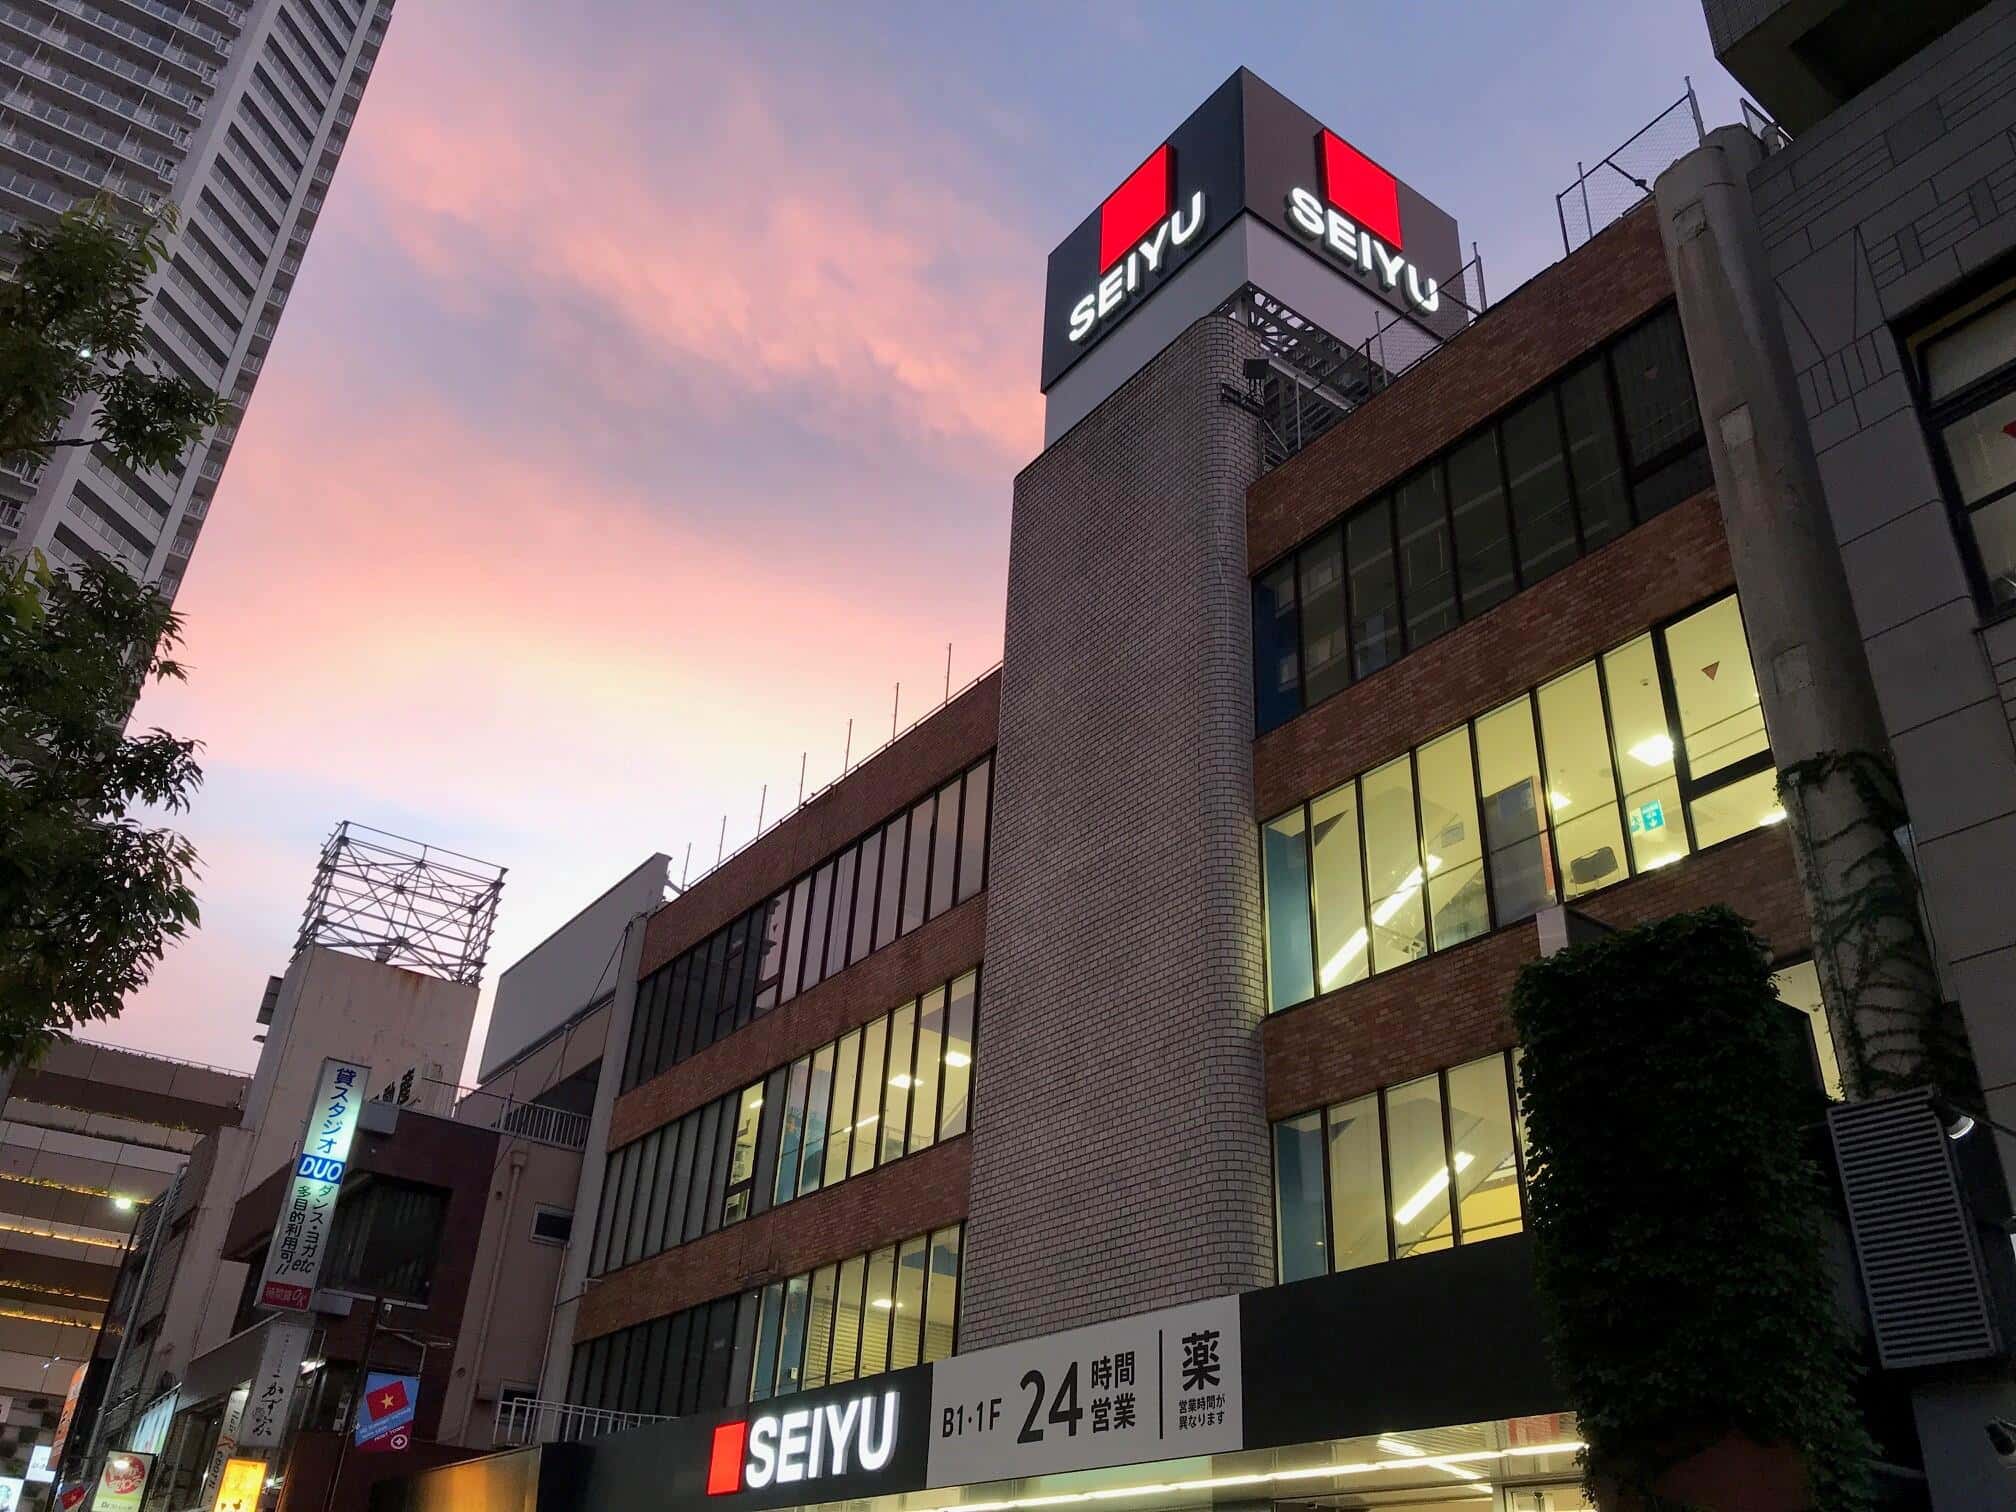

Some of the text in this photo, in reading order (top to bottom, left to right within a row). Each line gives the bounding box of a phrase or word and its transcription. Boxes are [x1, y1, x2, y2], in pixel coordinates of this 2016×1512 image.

[1069, 190, 1204, 342] SEIYU
[1288, 187, 1440, 312] SEIYU
[317, 1067, 357, 1154] 貸スタジオ
[299, 1156, 343, 1181] DUO
[1091, 1351, 1135, 1390] 時間
[1182, 1329, 1220, 1391] 薬
[1017, 1361, 1083, 1444] 24
[1091, 1392, 1136, 1434] 営業
[1179, 1393, 1226, 1414] 営業時間が
[1179, 1411, 1225, 1431] 異なります
[746, 1391, 899, 1488] SEIYU
